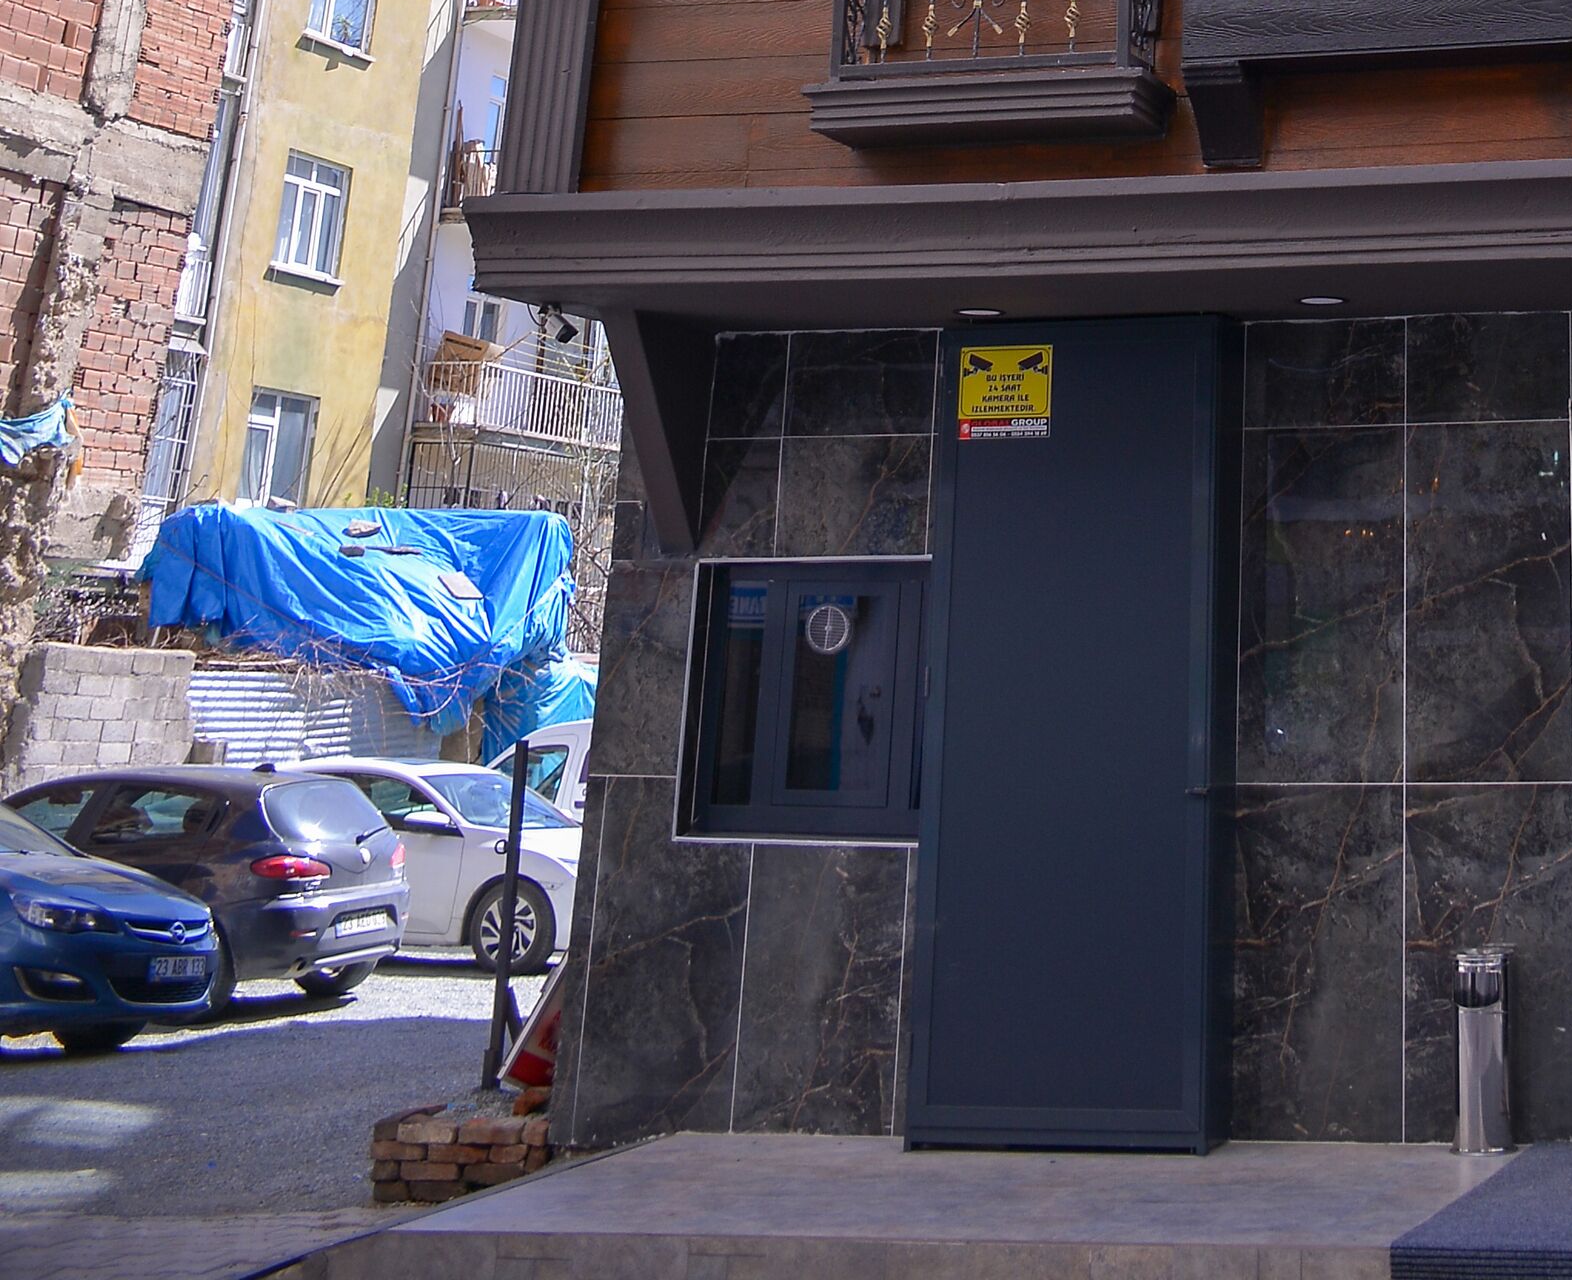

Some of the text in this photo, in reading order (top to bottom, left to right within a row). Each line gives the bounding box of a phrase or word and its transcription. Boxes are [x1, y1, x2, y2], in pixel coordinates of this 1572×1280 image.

[986, 374, 997, 382] BU
[982, 394, 1015, 402] KAMERA
[1011, 418, 1048, 426] GROUP
[156, 959, 169, 976] 23
